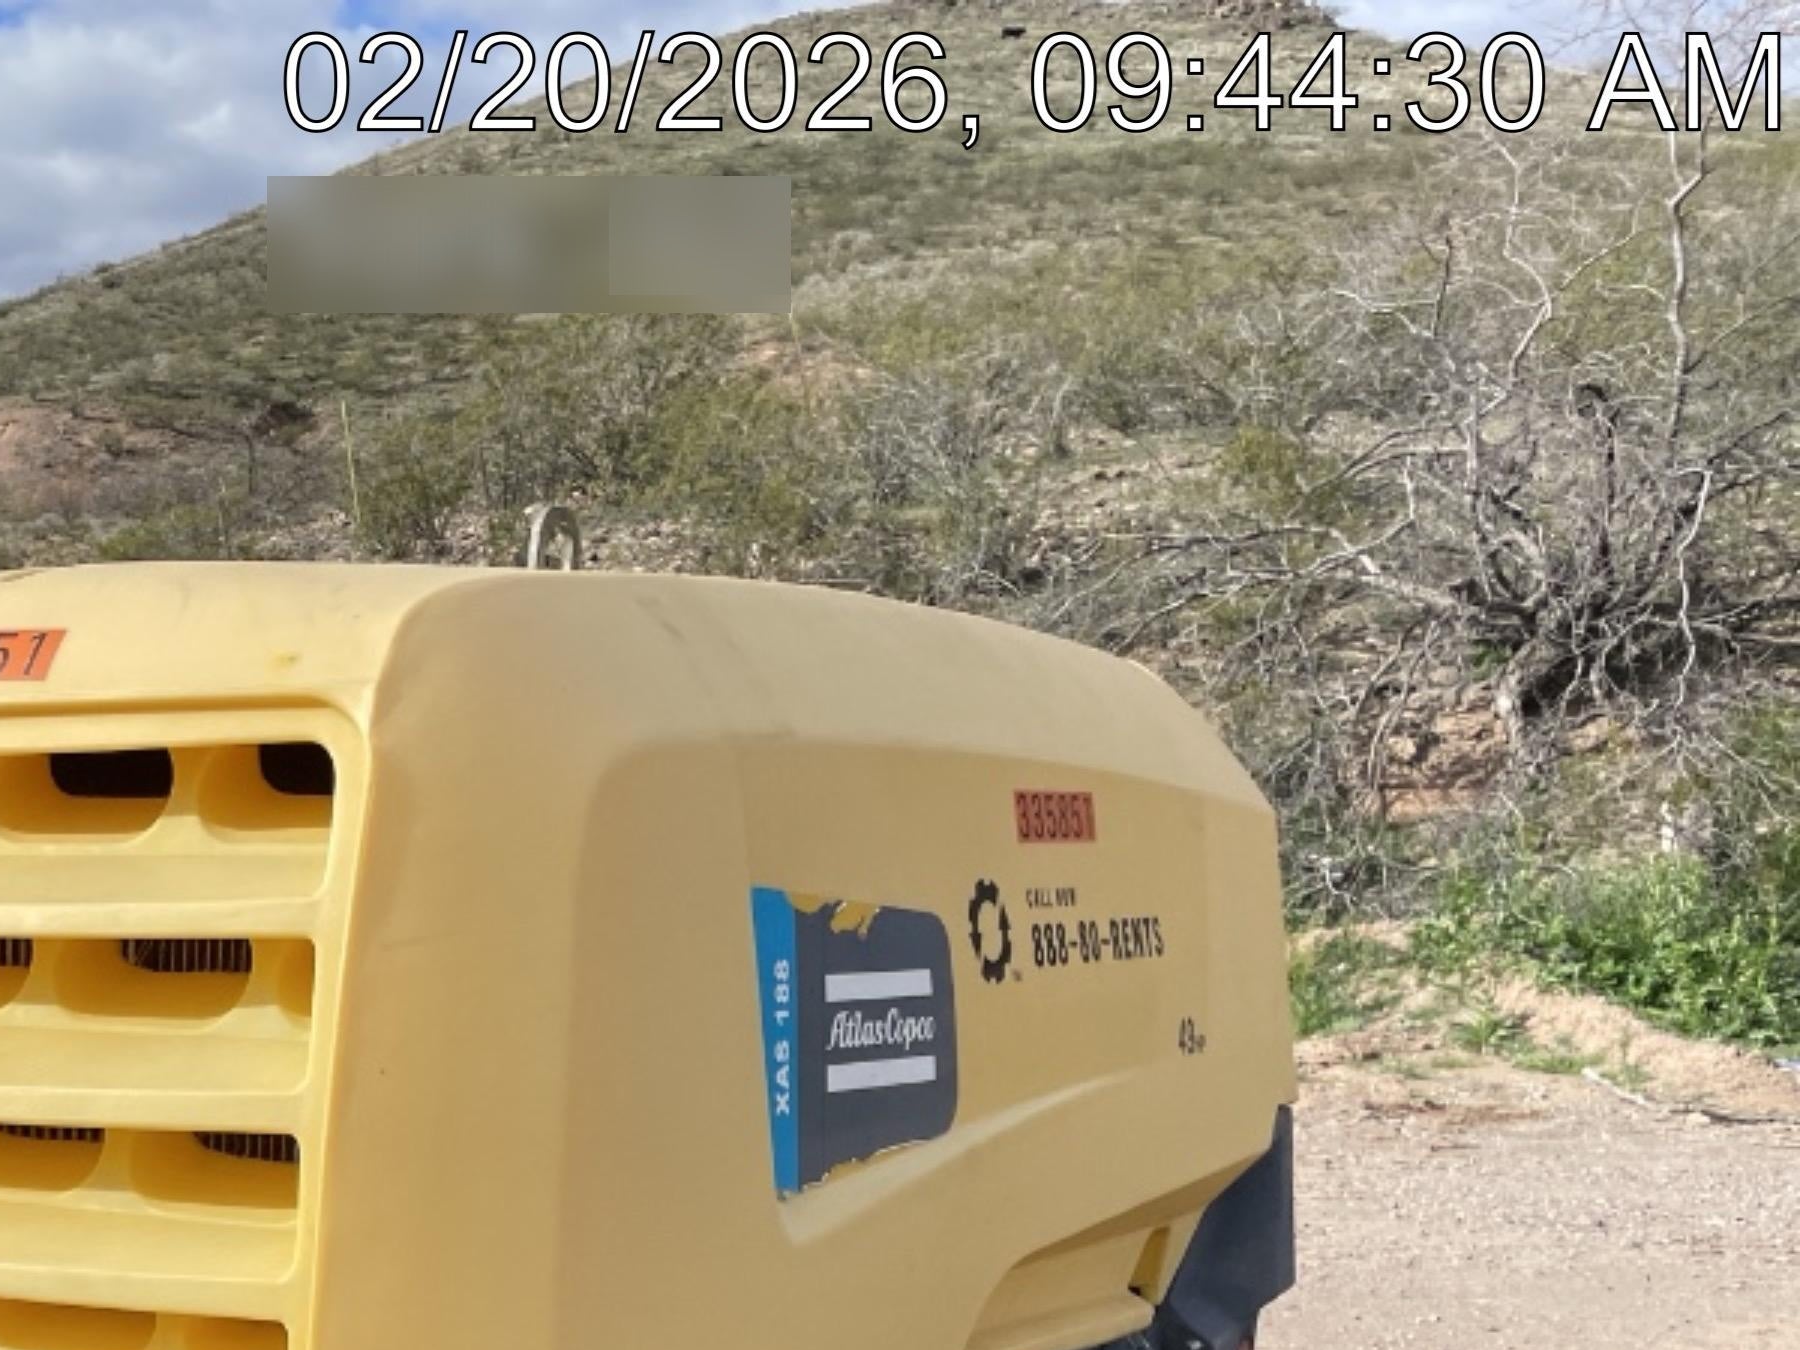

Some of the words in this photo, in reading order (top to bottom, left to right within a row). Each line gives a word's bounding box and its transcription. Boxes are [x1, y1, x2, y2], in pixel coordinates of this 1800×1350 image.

[1016, 793, 1094, 839] 335851
[1031, 916, 1164, 968] 888-80-RENTS
[774, 959, 790, 1026] 188
[774, 1040, 790, 1116] XAS
